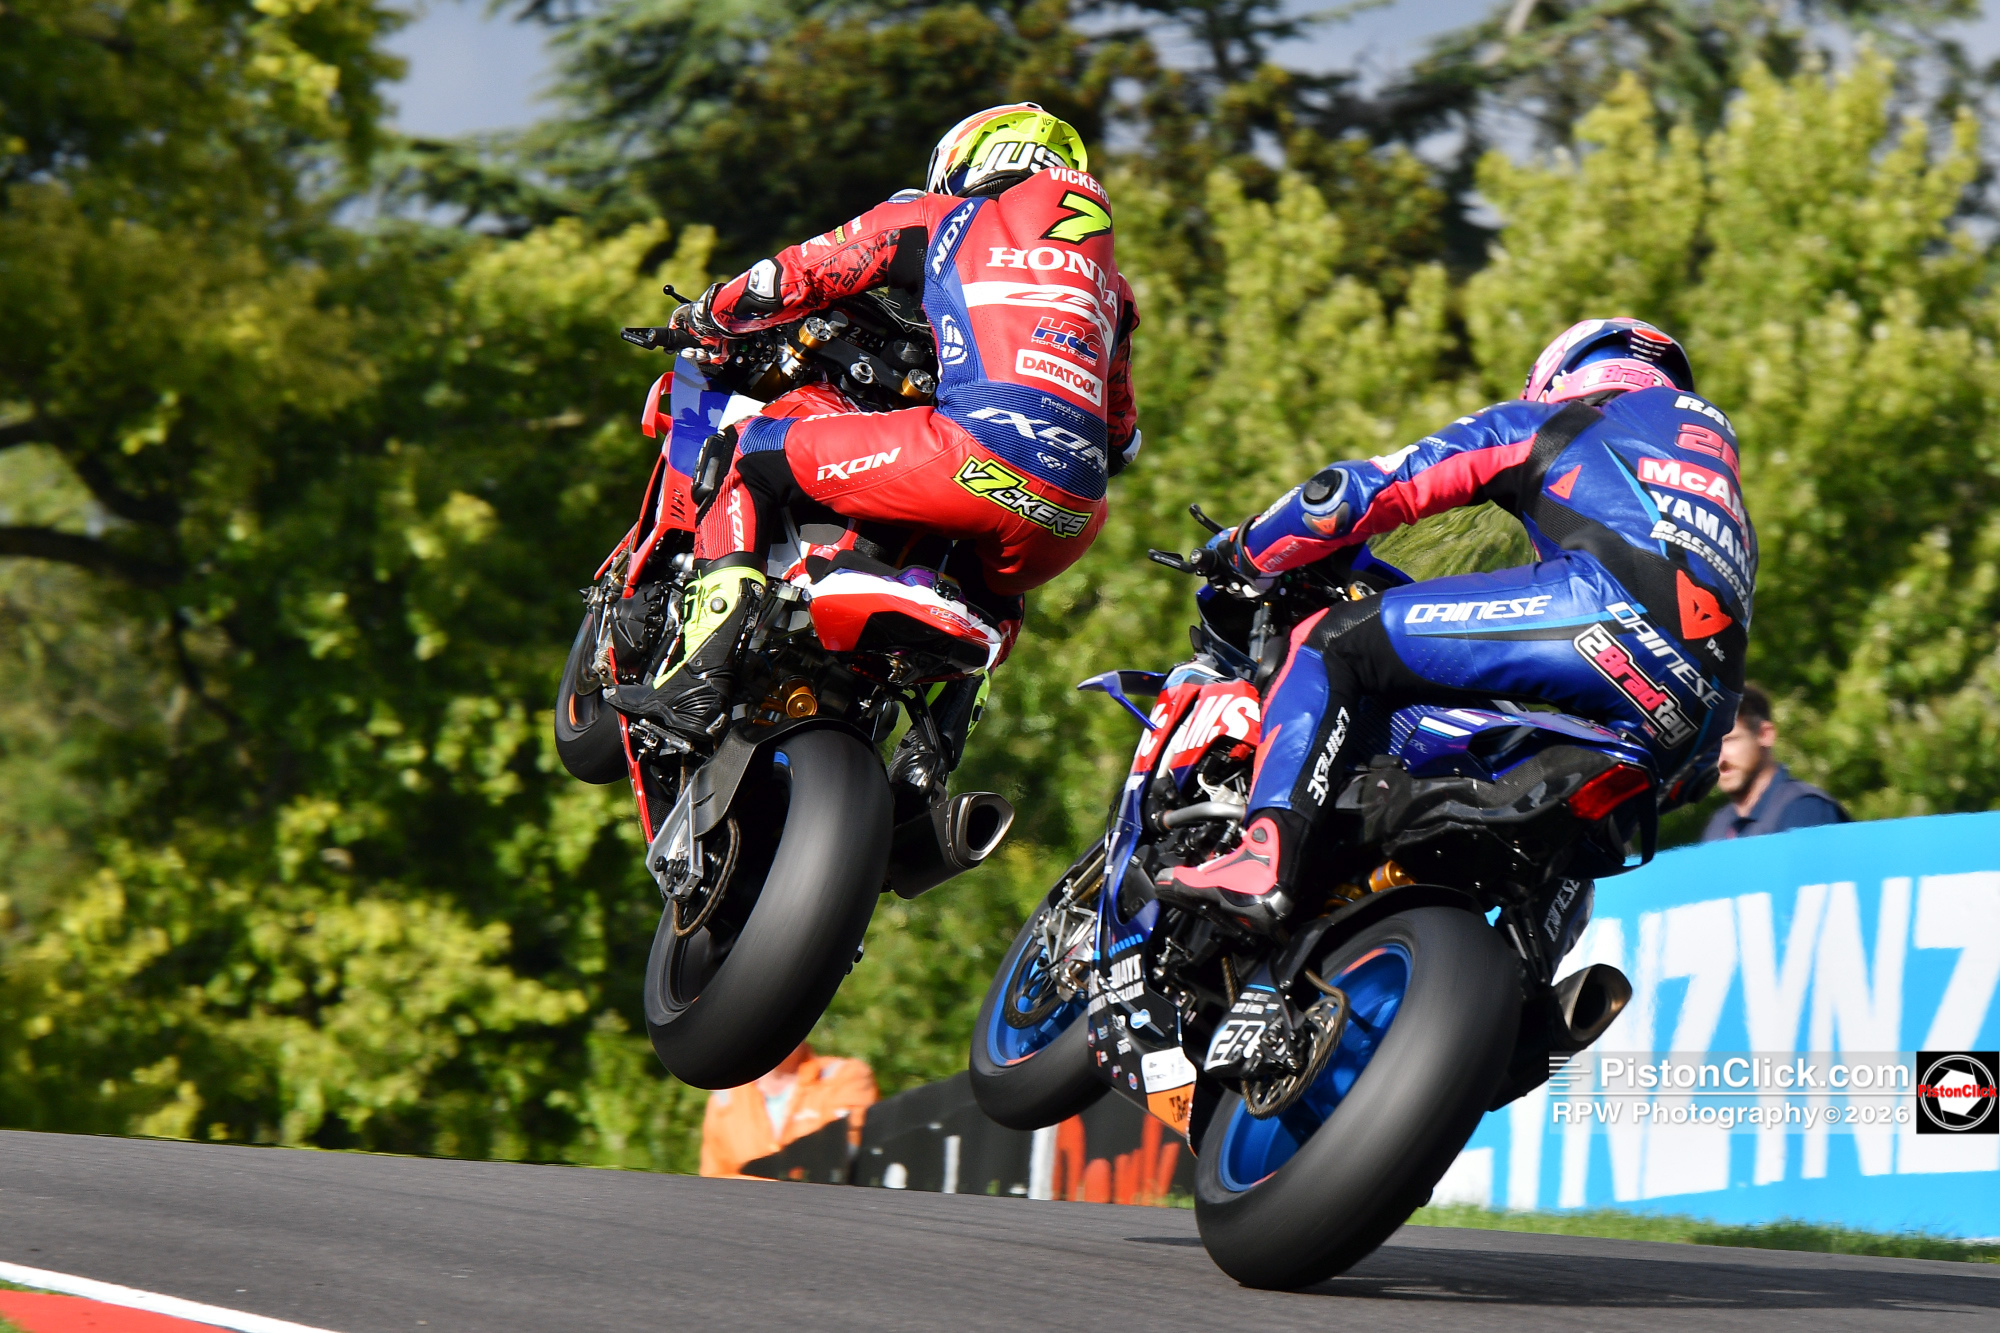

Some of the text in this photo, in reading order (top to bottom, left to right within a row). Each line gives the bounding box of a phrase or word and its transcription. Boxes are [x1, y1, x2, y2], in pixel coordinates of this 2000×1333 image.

[1038, 190, 1113, 245] 7
[986, 246, 1118, 319] HONDA
[1022, 355, 1099, 399] DATATOOL
[1674, 394, 1737, 437] RAY
[1404, 596, 1552, 624] DAINESE
[1605, 601, 1725, 709] DAINESE
